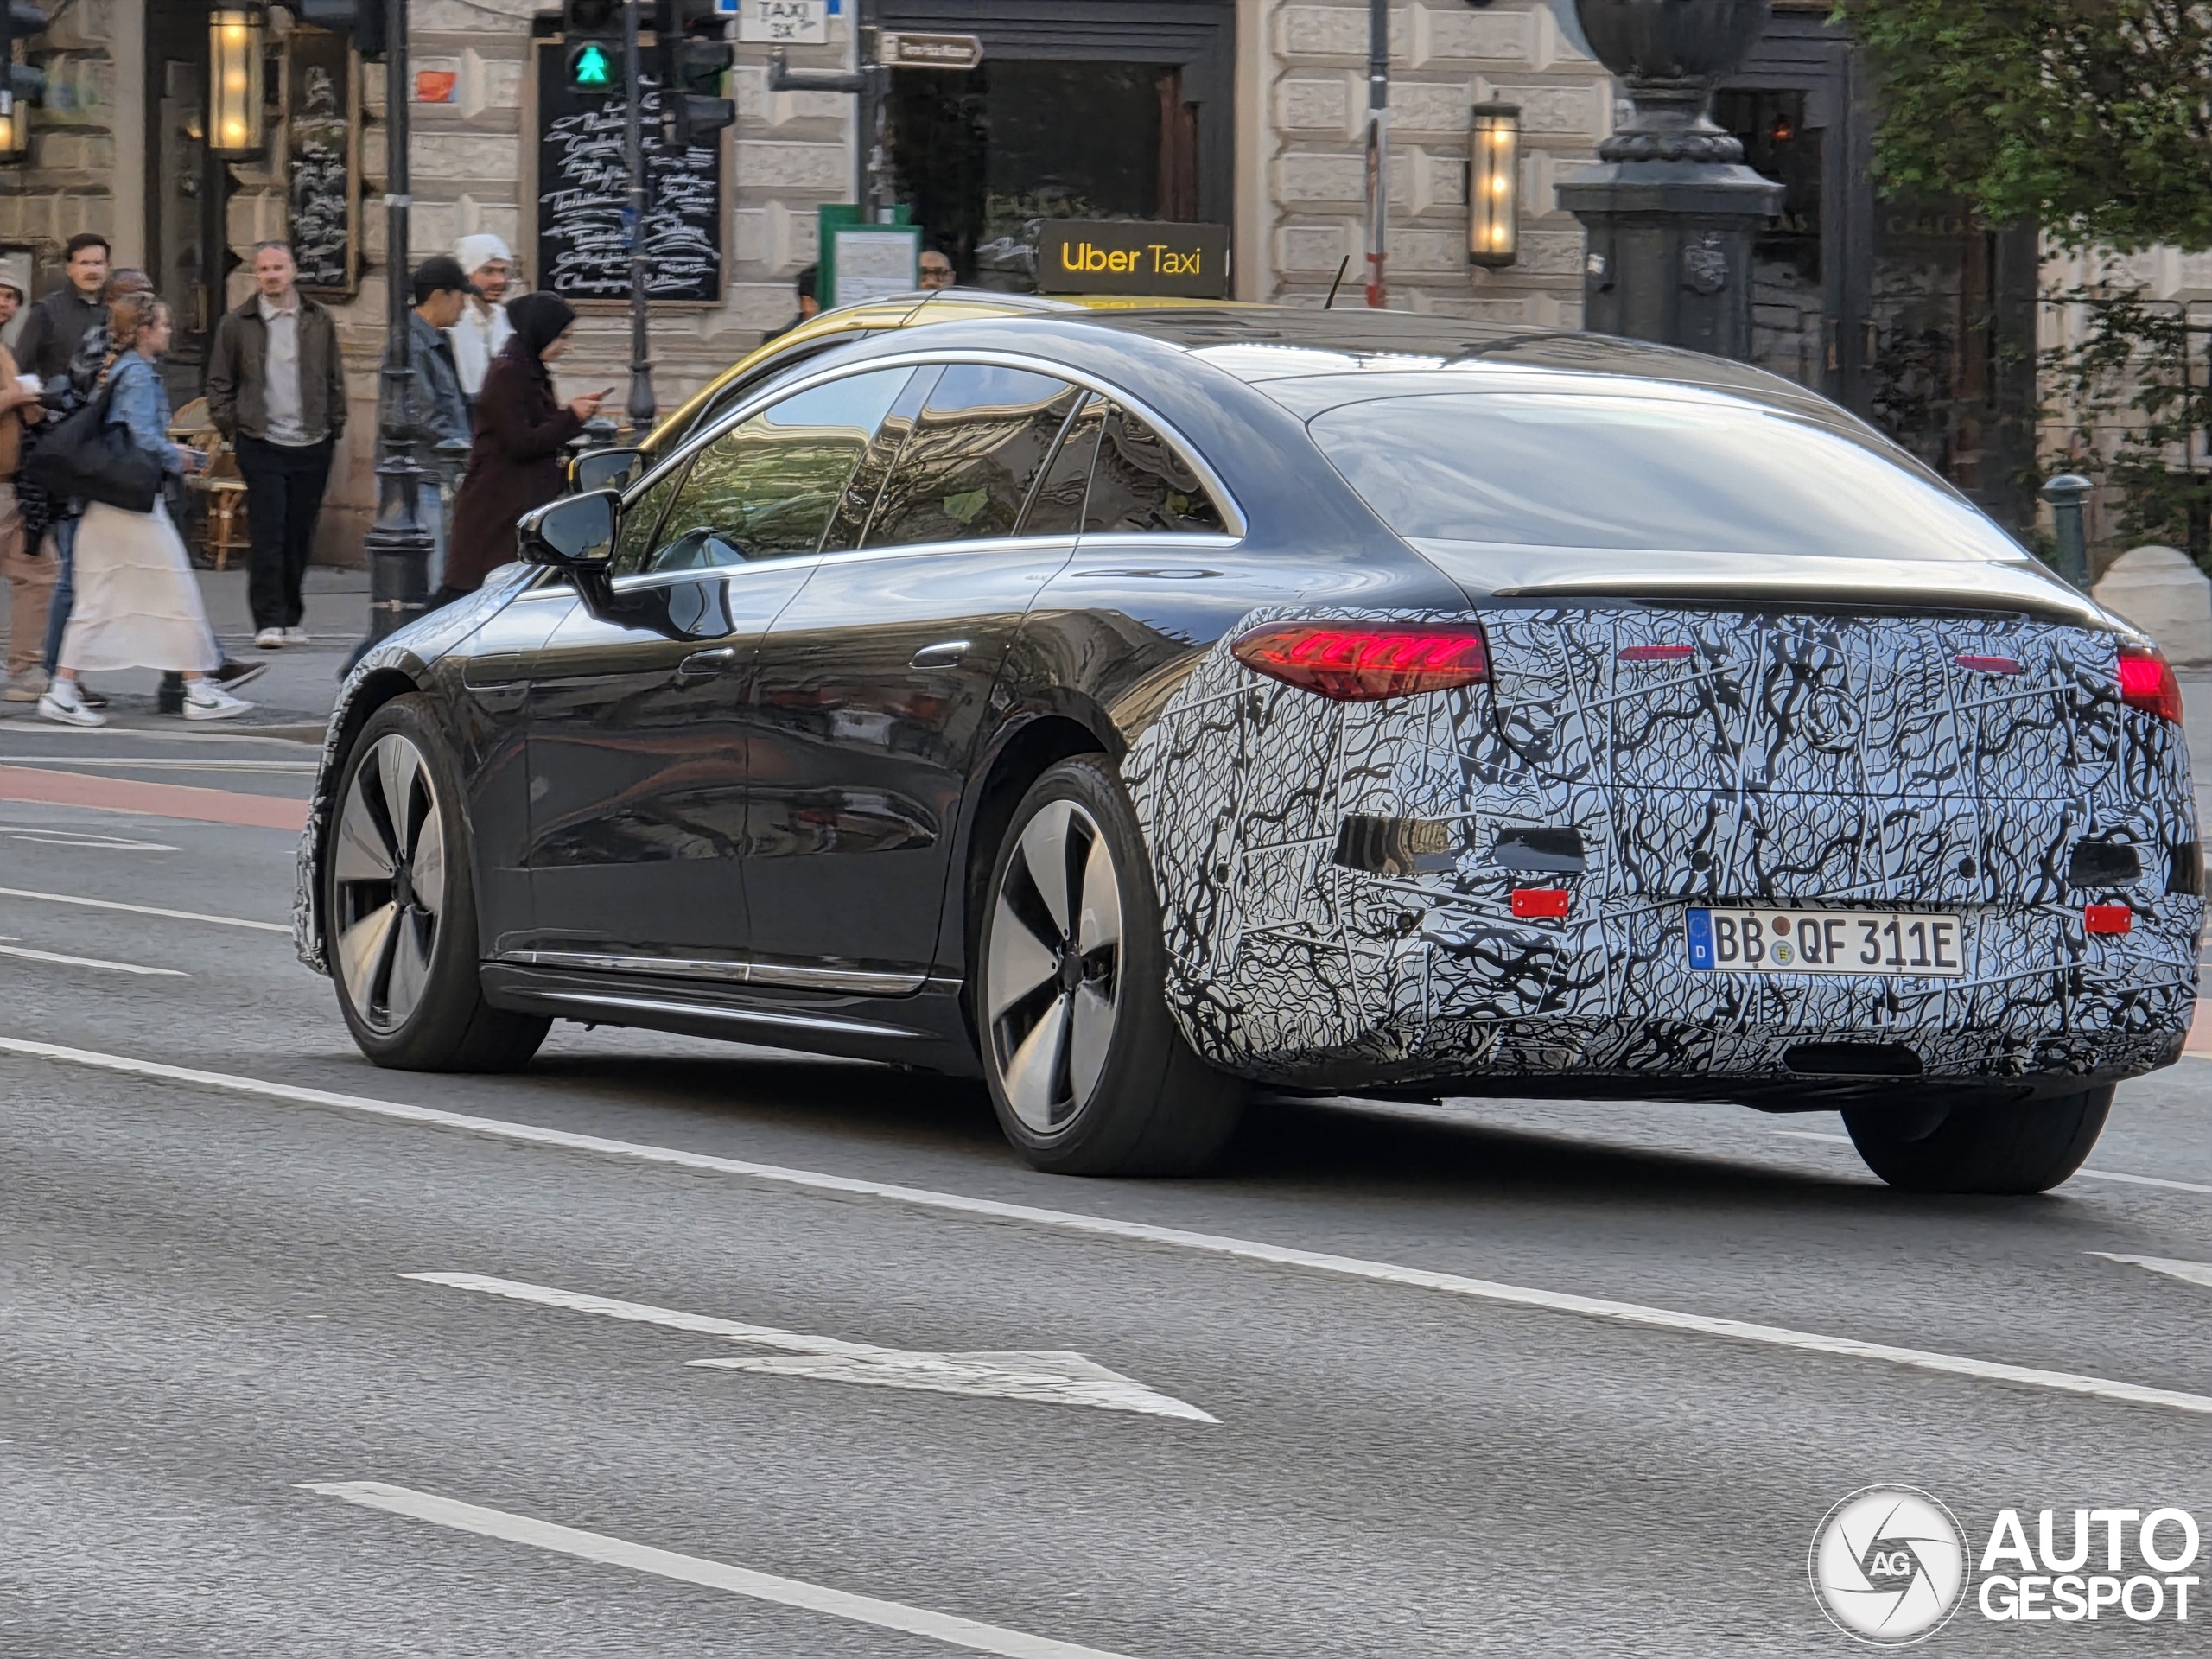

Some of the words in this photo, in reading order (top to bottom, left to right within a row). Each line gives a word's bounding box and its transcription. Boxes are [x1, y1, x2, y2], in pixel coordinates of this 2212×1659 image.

[758, 1, 809, 19] TAXI
[1062, 241, 1141, 272] Uber
[1147, 245, 1201, 275] Taxi
[1695, 944, 1707, 959] D
[1714, 916, 1766, 963] BB
[1797, 918, 1847, 964] QF
[1857, 919, 1958, 968] 311E
